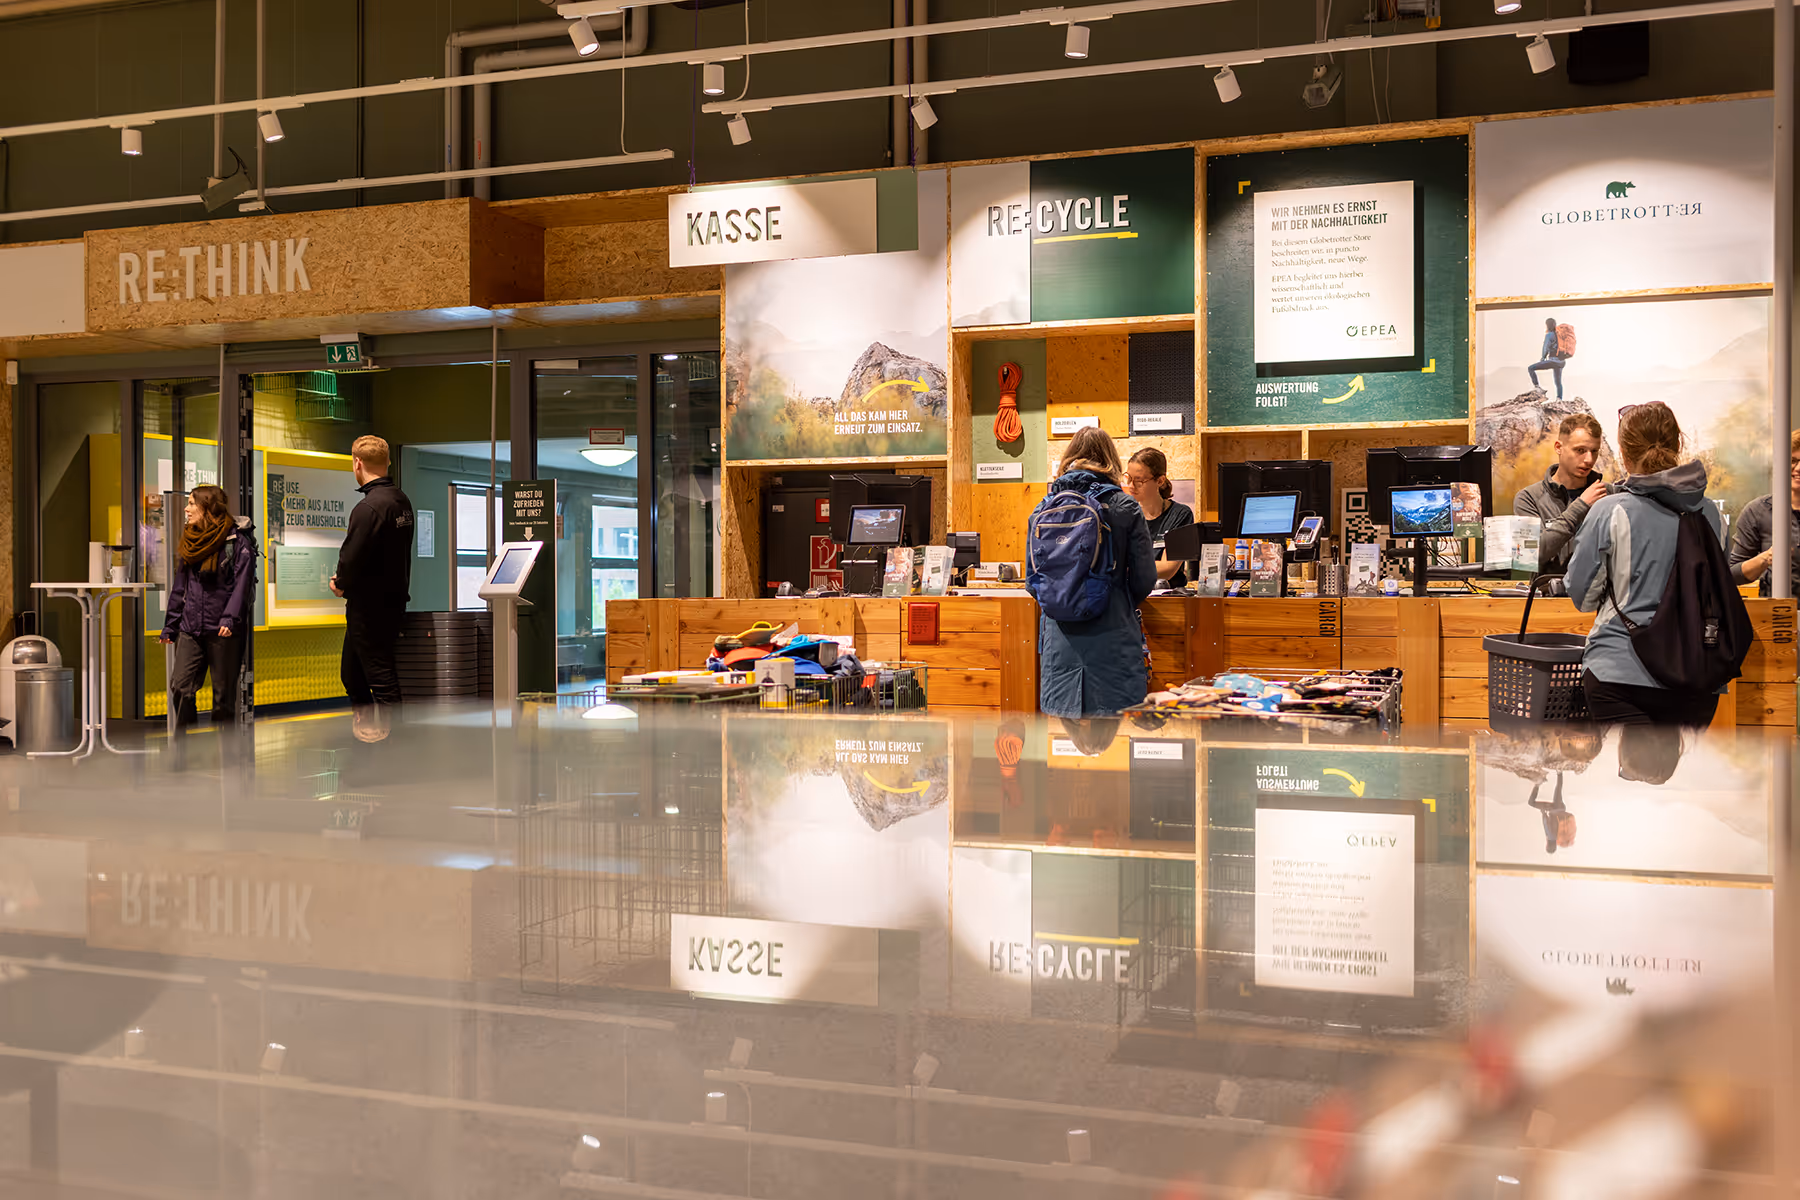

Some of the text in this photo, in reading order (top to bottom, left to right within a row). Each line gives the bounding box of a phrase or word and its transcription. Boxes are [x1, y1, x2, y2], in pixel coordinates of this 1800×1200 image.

[1271, 200, 1377, 217] WIR NEHMEN ES ERNST
[987, 195, 1130, 236] RE:CYCLE
[687, 206, 781, 246] KASSE
[1271, 213, 1387, 231] MIT DER NACHHALTIGKEIT
[1309, 236, 1351, 244] Globetrotter
[1334, 245, 1359, 255] puncto
[119, 238, 311, 304] RE:THINK
[1293, 273, 1322, 282] begleitet
[1339, 270, 1363, 278] hierbei
[1272, 281, 1343, 292] wissenschaftlich und
[1324, 291, 1370, 300] ökologischen
[1361, 325, 1396, 336] EPEA
[1255, 382, 1318, 394] AUSWERTUNG
[1255, 396, 1287, 407] FOLGT!
[834, 410, 908, 422] ALL DAS KAM HIER
[834, 422, 923, 434] ERNEUT ZUM EINSATZ.
[534, 490, 542, 498] DU
[286, 497, 344, 512] MEHR AUS ALTEM
[513, 500, 544, 508] ZUFRIEDEN
[286, 514, 347, 528] ZEUG RAUSHOLEN.
[1319, 602, 1336, 635] CARGO
[1772, 606, 1792, 643] CARGO
